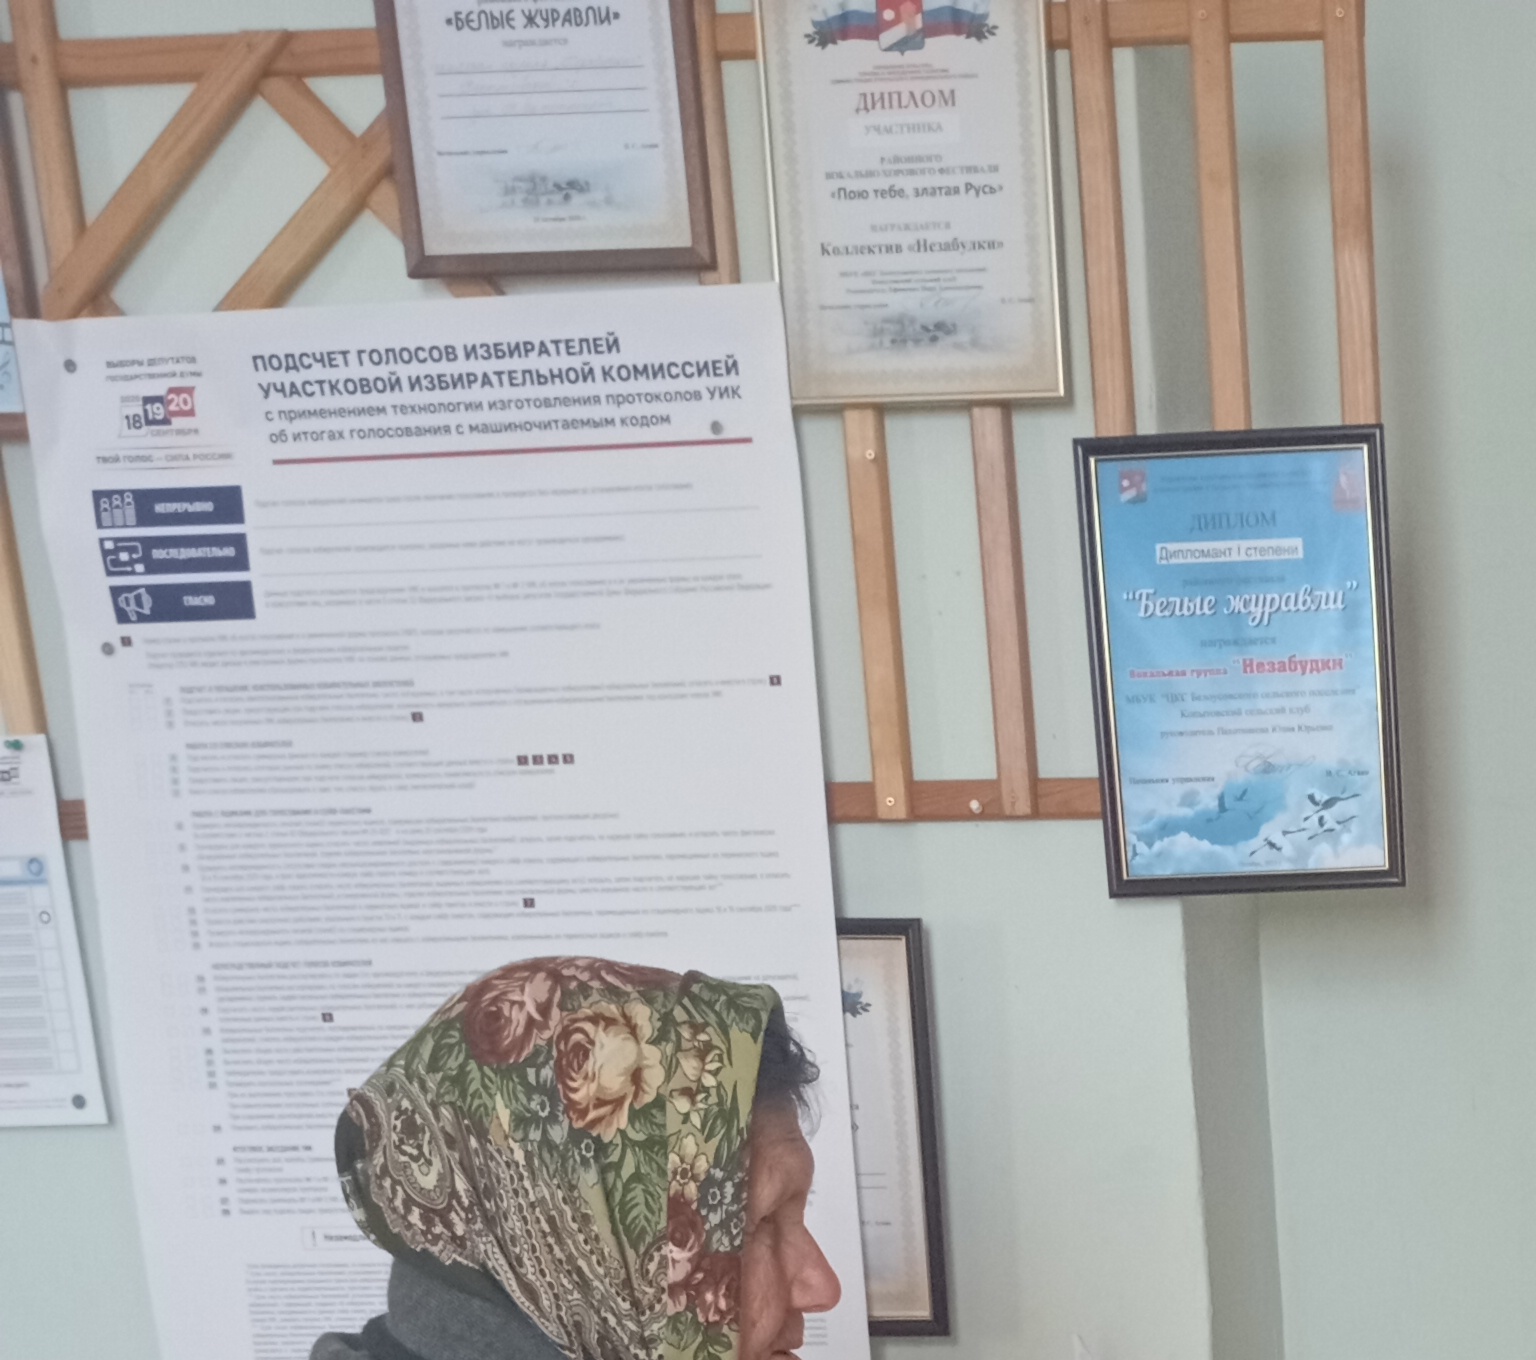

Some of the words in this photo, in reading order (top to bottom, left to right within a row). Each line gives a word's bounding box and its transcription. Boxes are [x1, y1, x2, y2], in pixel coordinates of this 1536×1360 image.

[446, 8, 516, 32] «БЕЛЫЕ
[521, 5, 620, 29] ЖУРАВЛИ»
[855, 89, 957, 115] ДИПЛОМ
[831, 187, 869, 200] «Пою
[913, 184, 960, 197] златая
[965, 182, 1003, 198] Русь»
[821, 241, 903, 256] Коллектив
[252, 350, 351, 373] ПОДСЧЕТ
[356, 344, 458, 368] ГОЛОСОВ
[464, 334, 621, 362] ИЗБИРАТЕЛЕЙ
[258, 371, 403, 400] УЧАСТКОВОЙ
[409, 362, 596, 393] ИЗБИРАТЕЛЬНОЙ
[602, 356, 739, 382] КОМИССИЕЙ
[146, 402, 165, 420] 19
[168, 393, 192, 410] 20
[265, 411, 274, 422] с
[278, 404, 387, 423] применением
[391, 398, 484, 417] технологии
[488, 394, 601, 412] изготовления
[605, 389, 703, 409] протоколов
[707, 385, 742, 401] УИК
[126, 413, 142, 430] 18
[270, 428, 289, 444] об
[293, 425, 345, 442] итогах
[350, 422, 451, 441] голосования
[456, 424, 464, 436] с
[469, 414, 615, 436] машиночитаемым
[621, 412, 671, 429] кодом
[96, 455, 121, 464] ТВОЙ
[122, 454, 154, 463] ГОЛОС
[1189, 511, 1277, 532] ДИПЛОМ
[1159, 545, 1232, 563] Дипломант
[1245, 544, 1299, 557] степени
